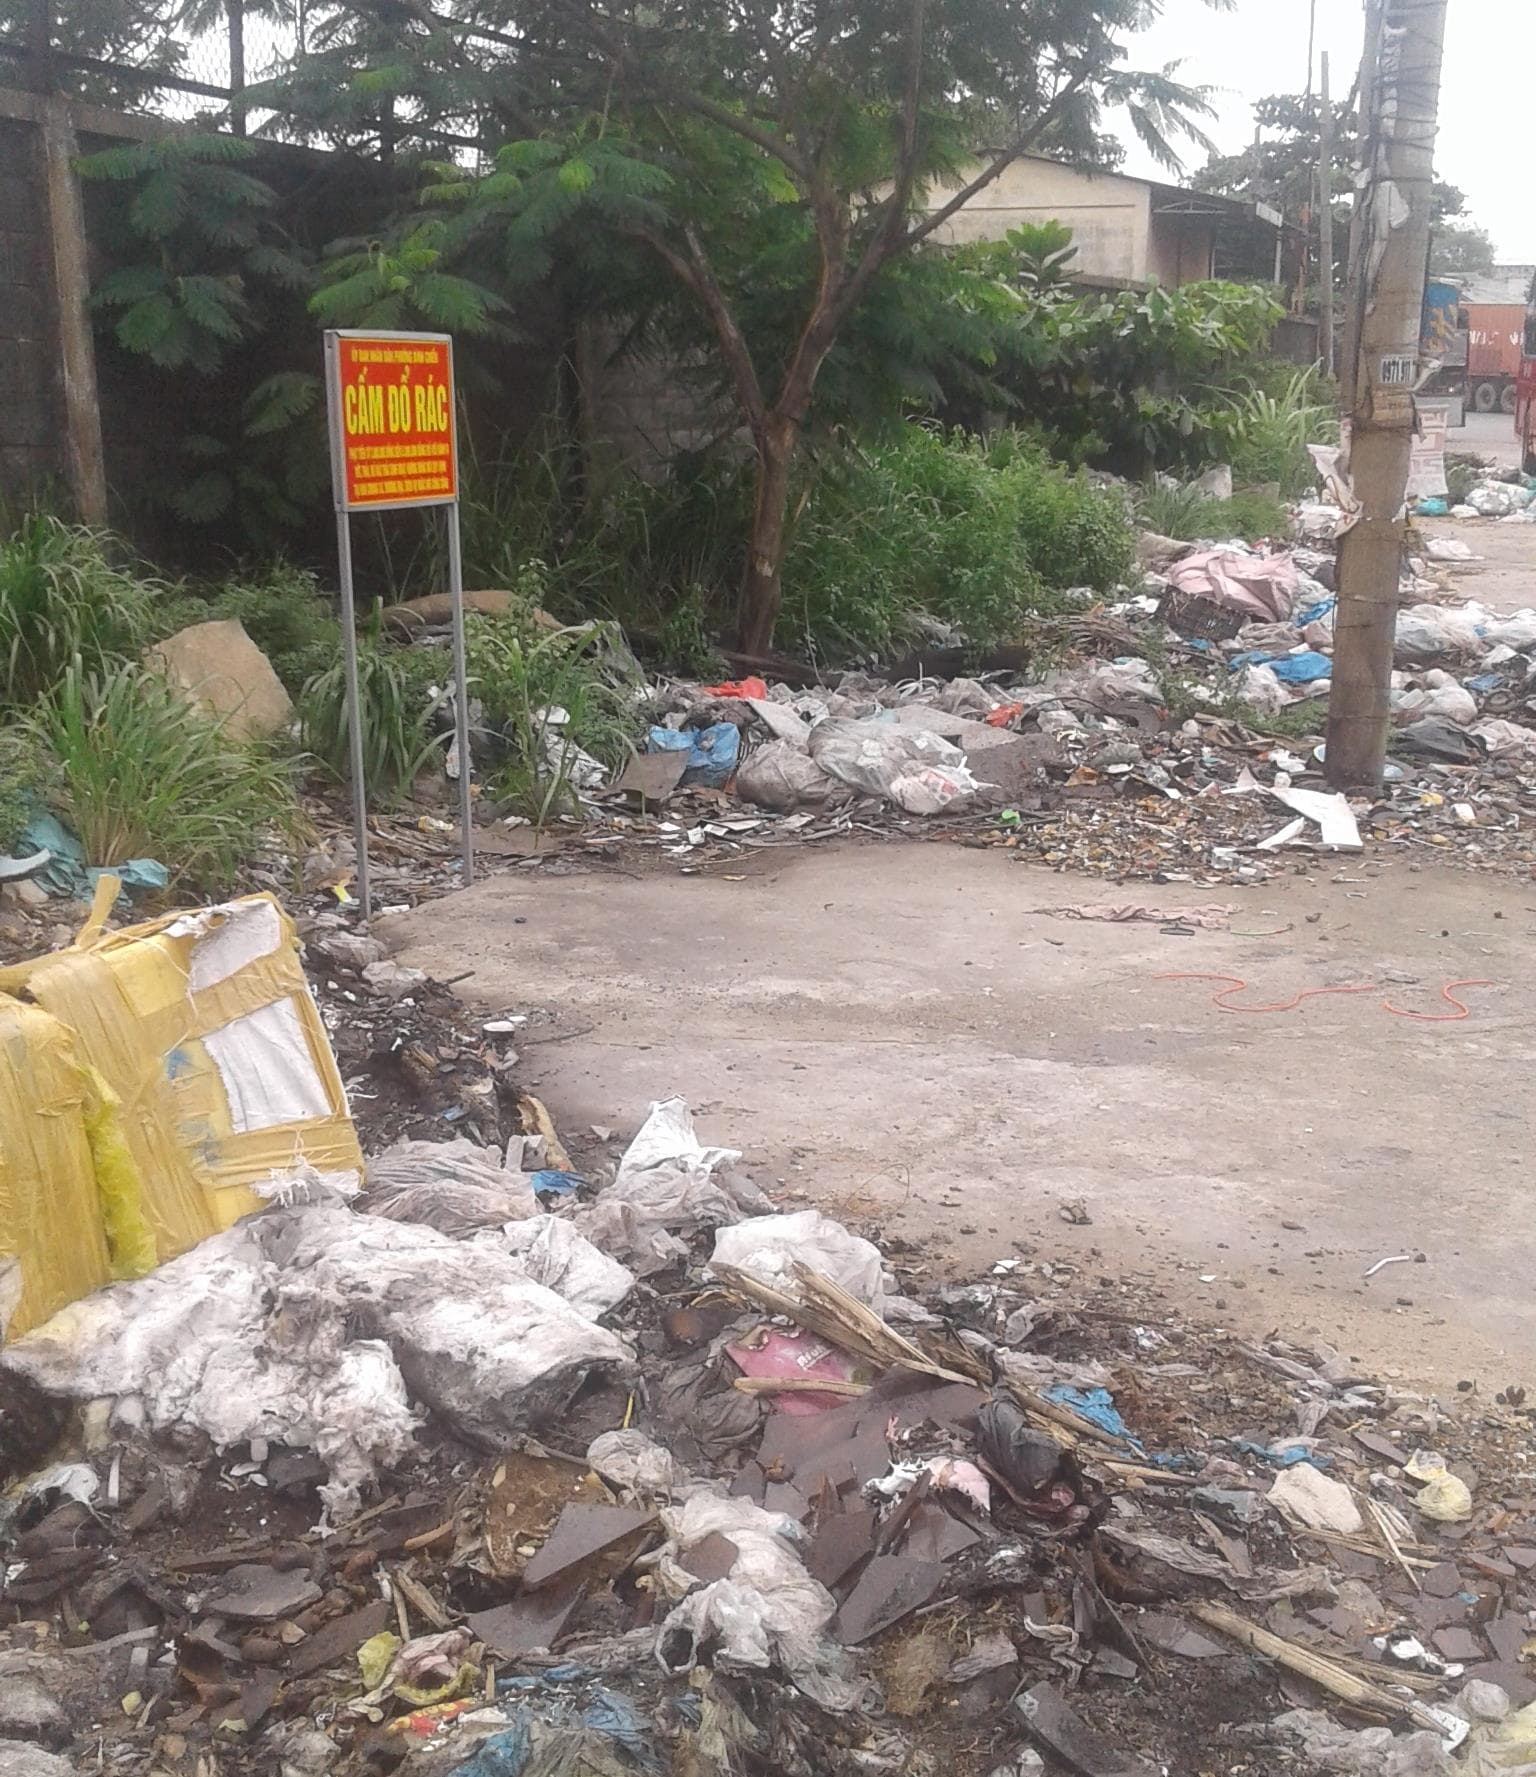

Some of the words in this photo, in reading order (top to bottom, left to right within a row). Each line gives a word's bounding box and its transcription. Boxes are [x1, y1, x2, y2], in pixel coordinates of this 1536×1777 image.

[345, 365, 385, 435] CẤM
[387, 364, 411, 433] ĐỔ
[414, 374, 449, 432] RÁC
